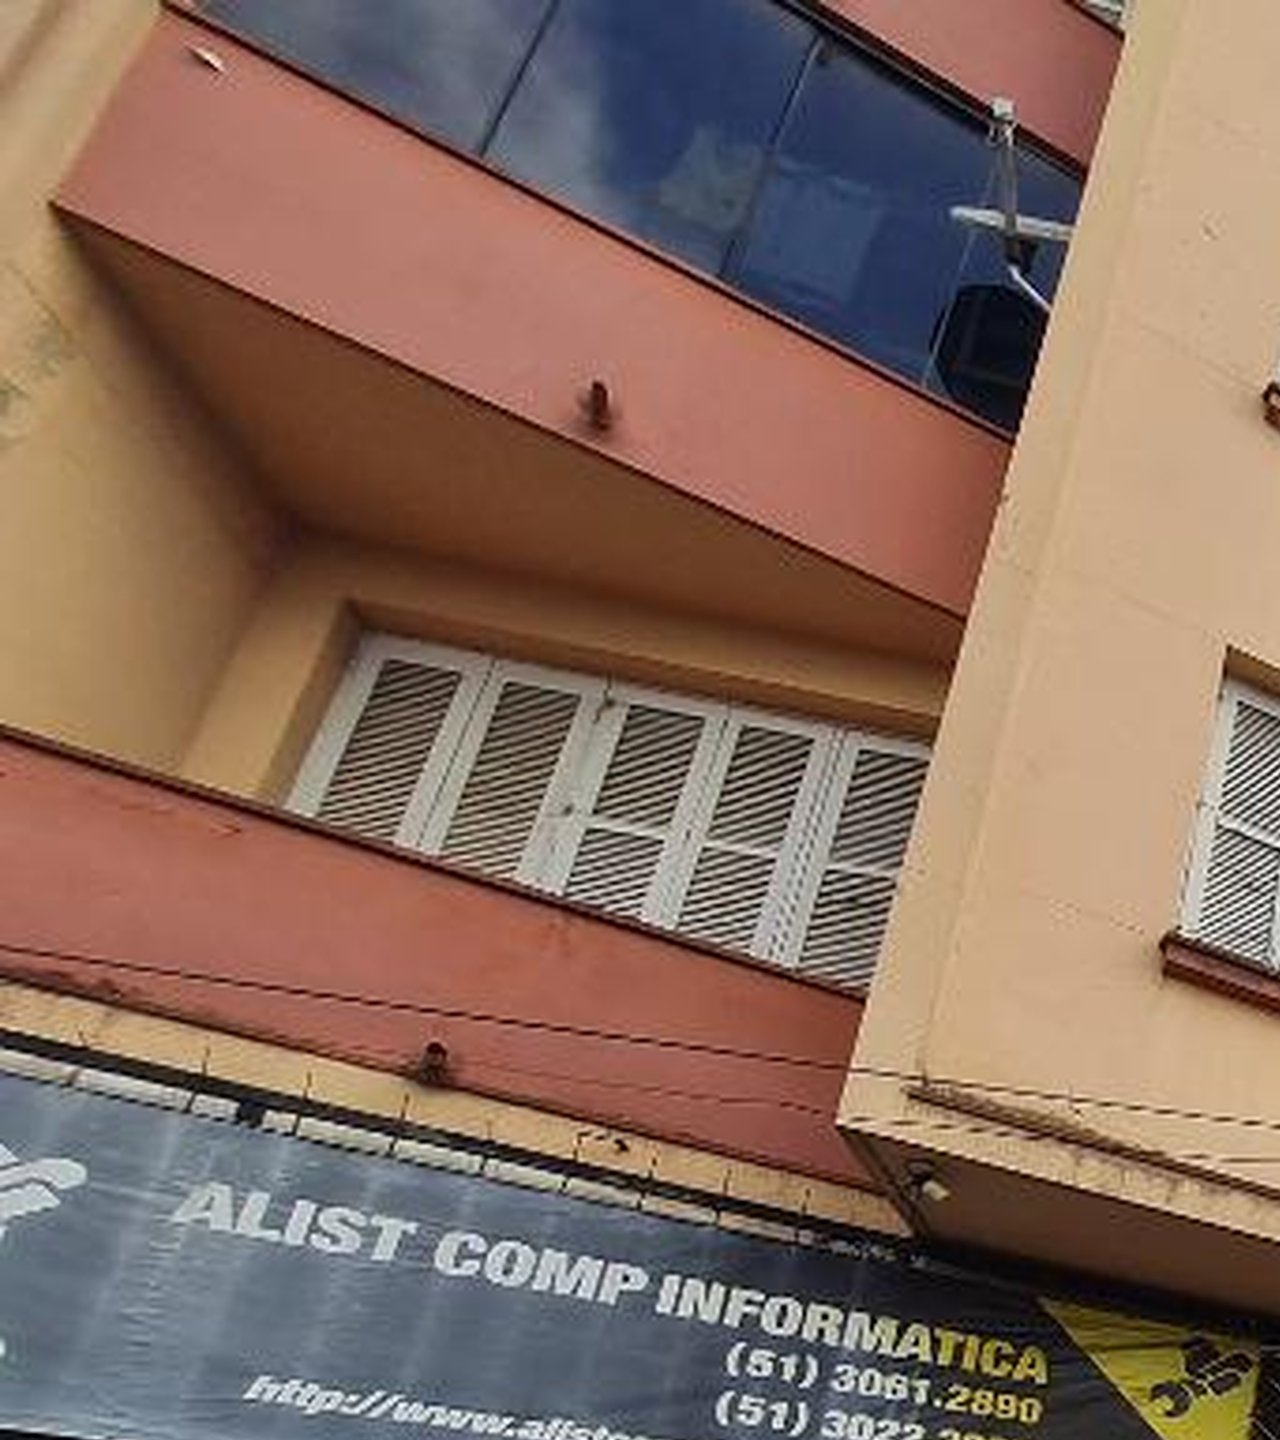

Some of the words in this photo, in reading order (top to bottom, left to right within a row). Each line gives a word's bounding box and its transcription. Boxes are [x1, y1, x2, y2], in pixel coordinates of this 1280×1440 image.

[170, 1182, 420, 1263] ALIST
[433, 1229, 649, 1307] COMP
[655, 1273, 1049, 1387] INFORMATICA
[715, 1395, 810, 1437] (51)
[725, 1342, 819, 1390] (51)
[829, 1364, 1043, 1425] 3061.2890
